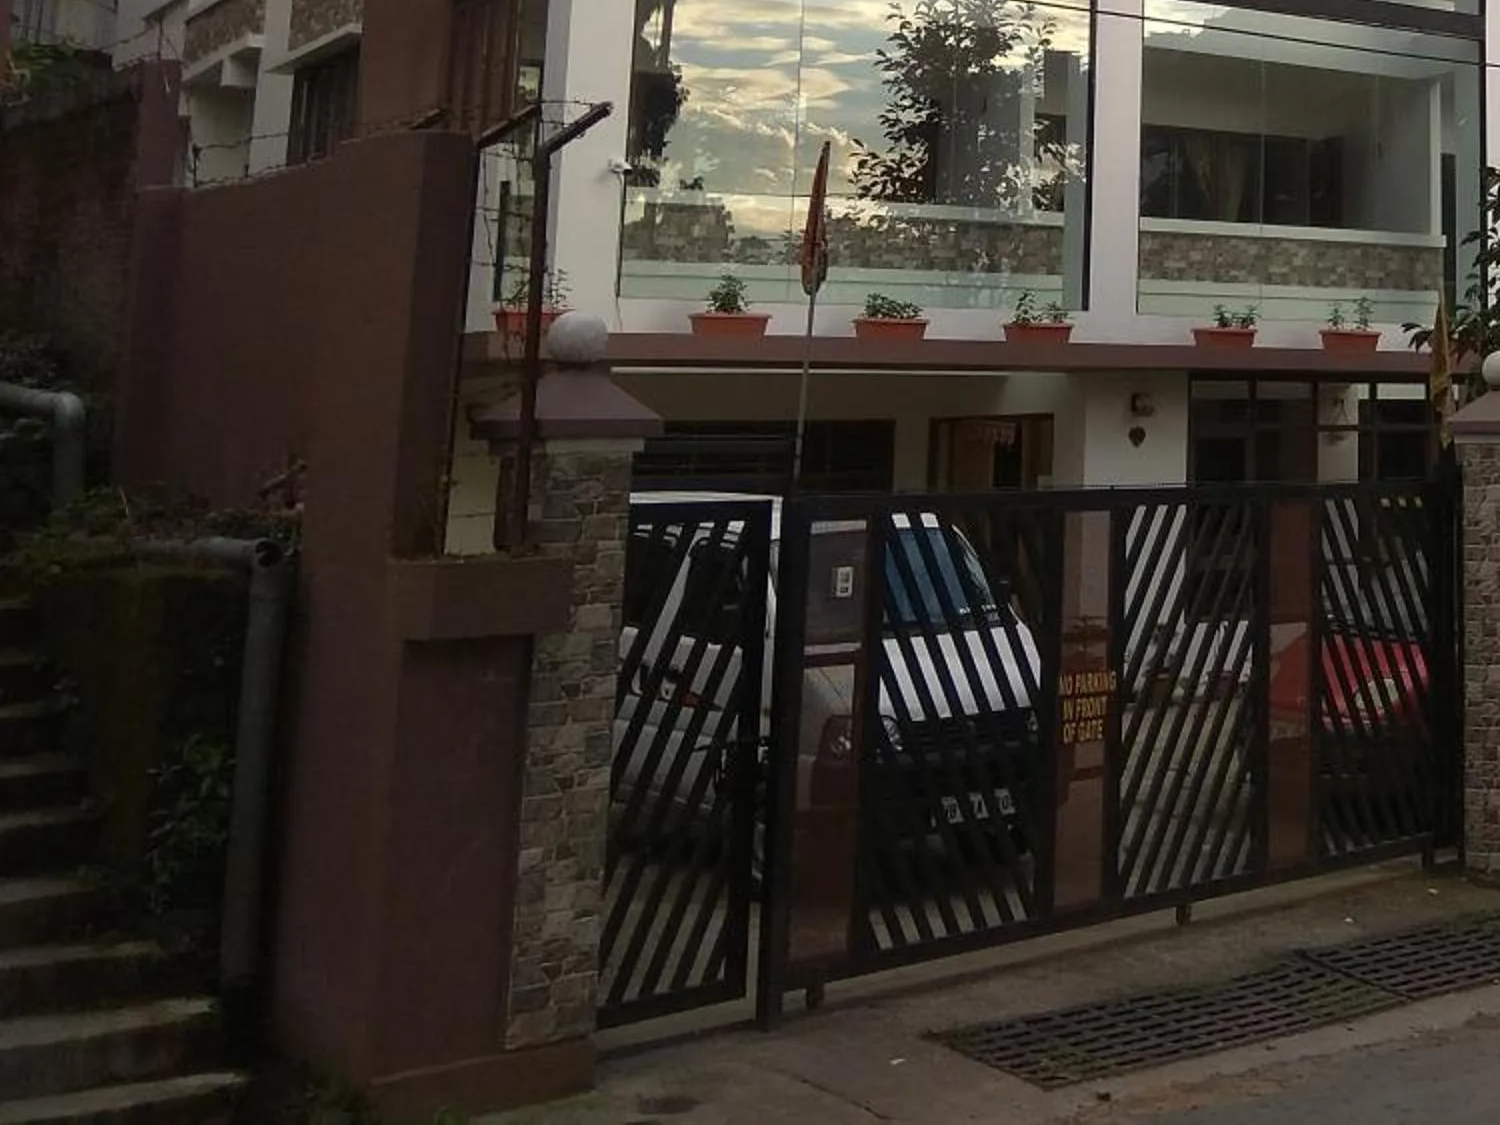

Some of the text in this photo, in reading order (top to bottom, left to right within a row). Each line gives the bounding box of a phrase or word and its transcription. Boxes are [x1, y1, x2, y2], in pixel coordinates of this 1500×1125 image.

[1058, 671, 1117, 695] NO PARKING
[1063, 696, 1108, 721] IN FRONT
[1063, 719, 1103, 744] OF GATE
